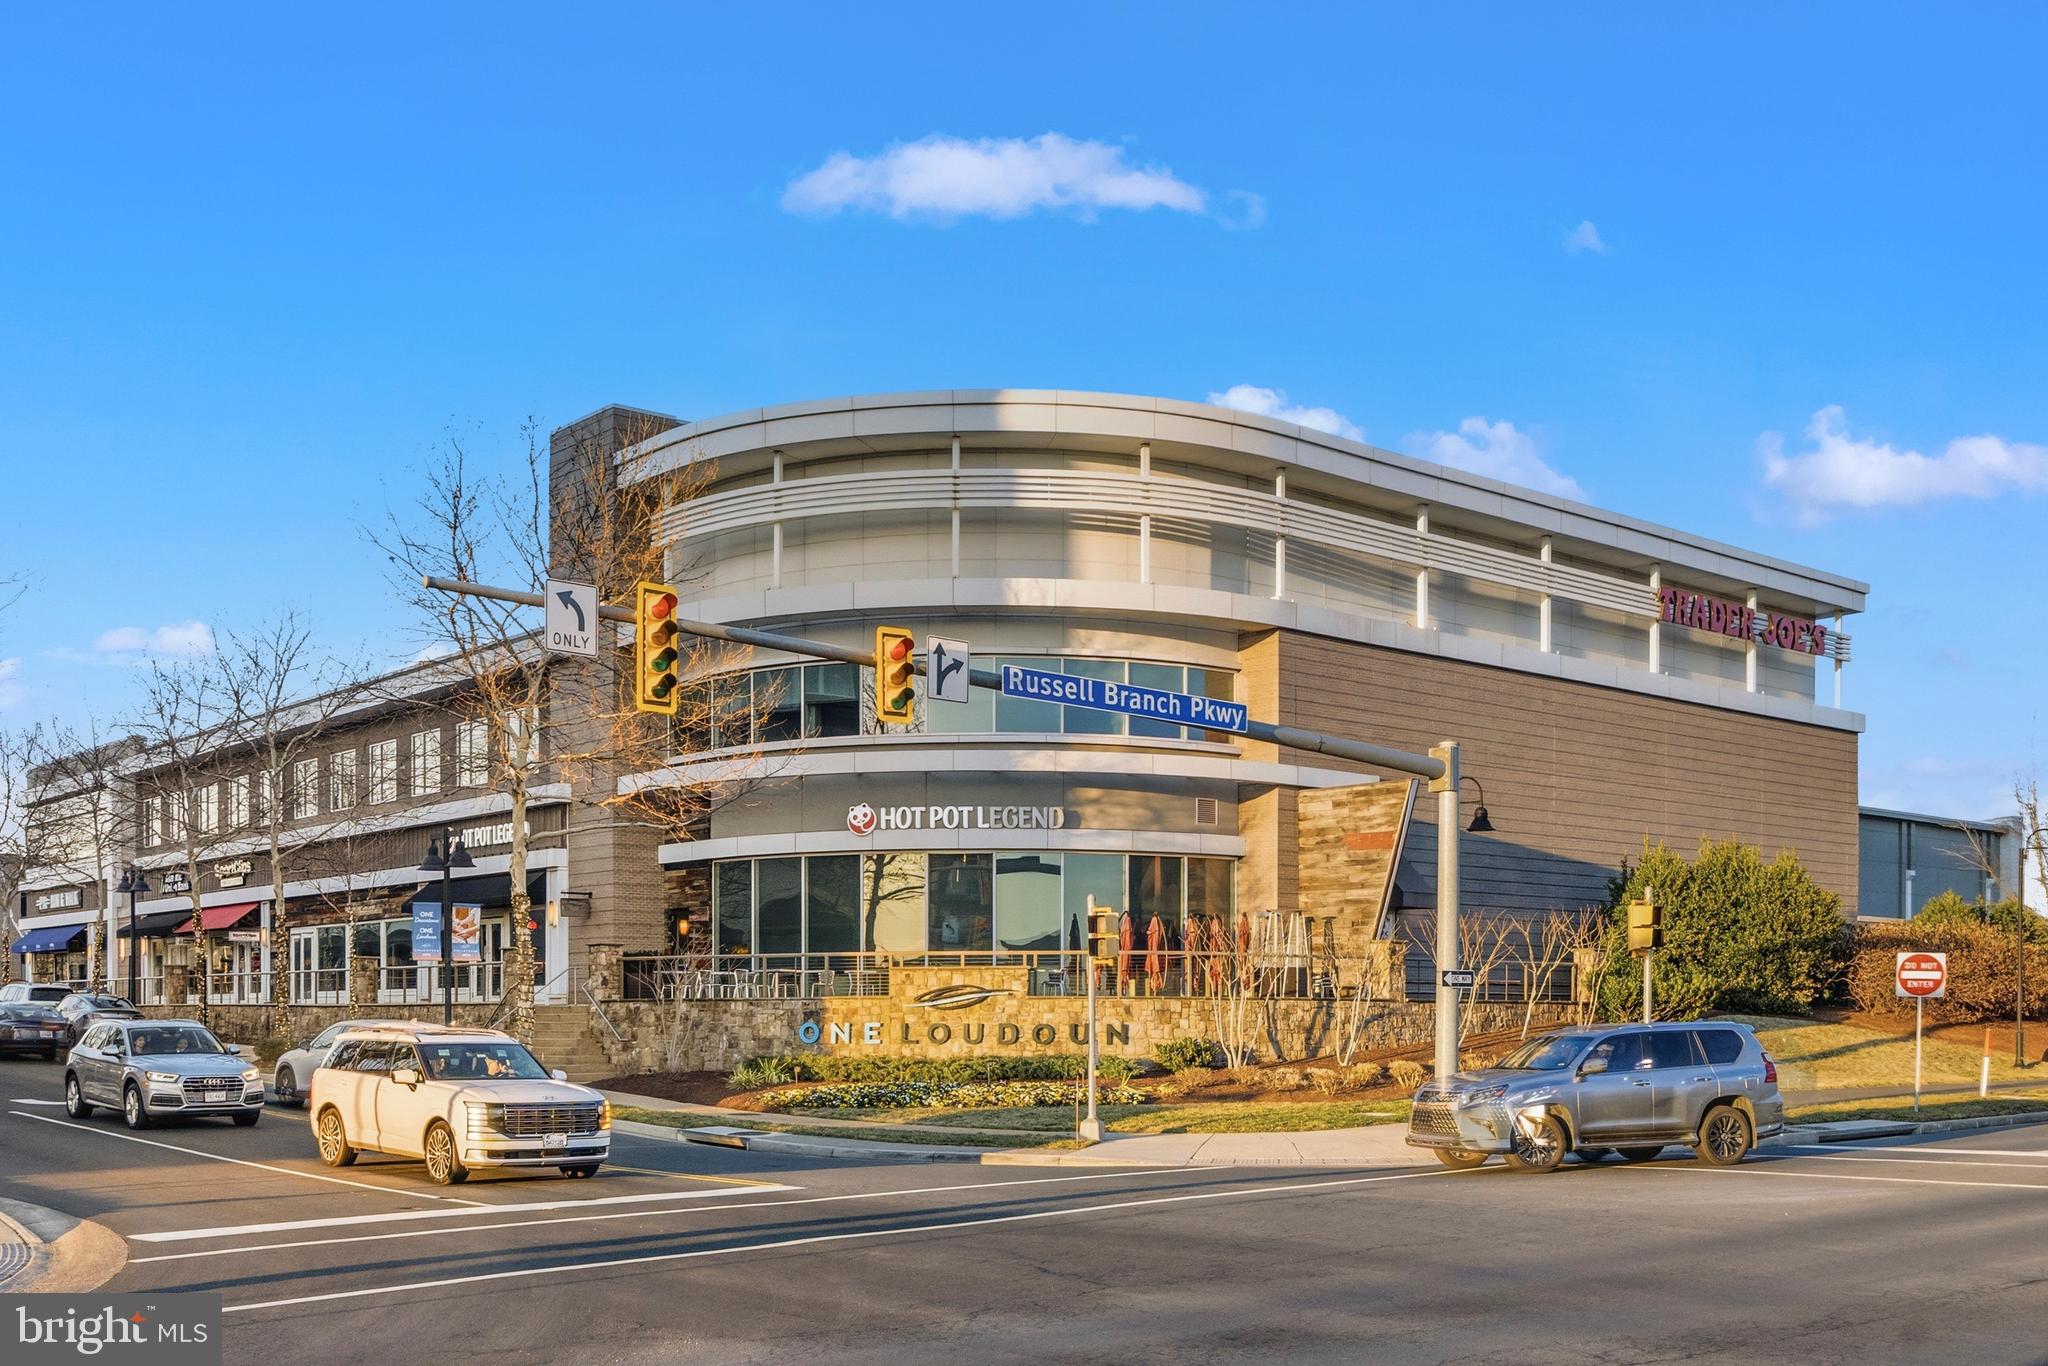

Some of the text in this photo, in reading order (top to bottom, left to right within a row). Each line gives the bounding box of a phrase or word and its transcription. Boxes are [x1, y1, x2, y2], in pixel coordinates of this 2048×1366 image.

[1658, 585, 1827, 656] TRADER JOE'S
[553, 632, 590, 649] ONLY
[1008, 667, 1244, 730] Russell Branch Pkwy
[880, 805, 1065, 830] HOT POT LEGEND
[474, 825, 493, 847] POT
[492, 820, 531, 845] LEGED
[1906, 980, 1934, 988] ENTER
[798, 1018, 1130, 1047] ONE LOUDOUN
